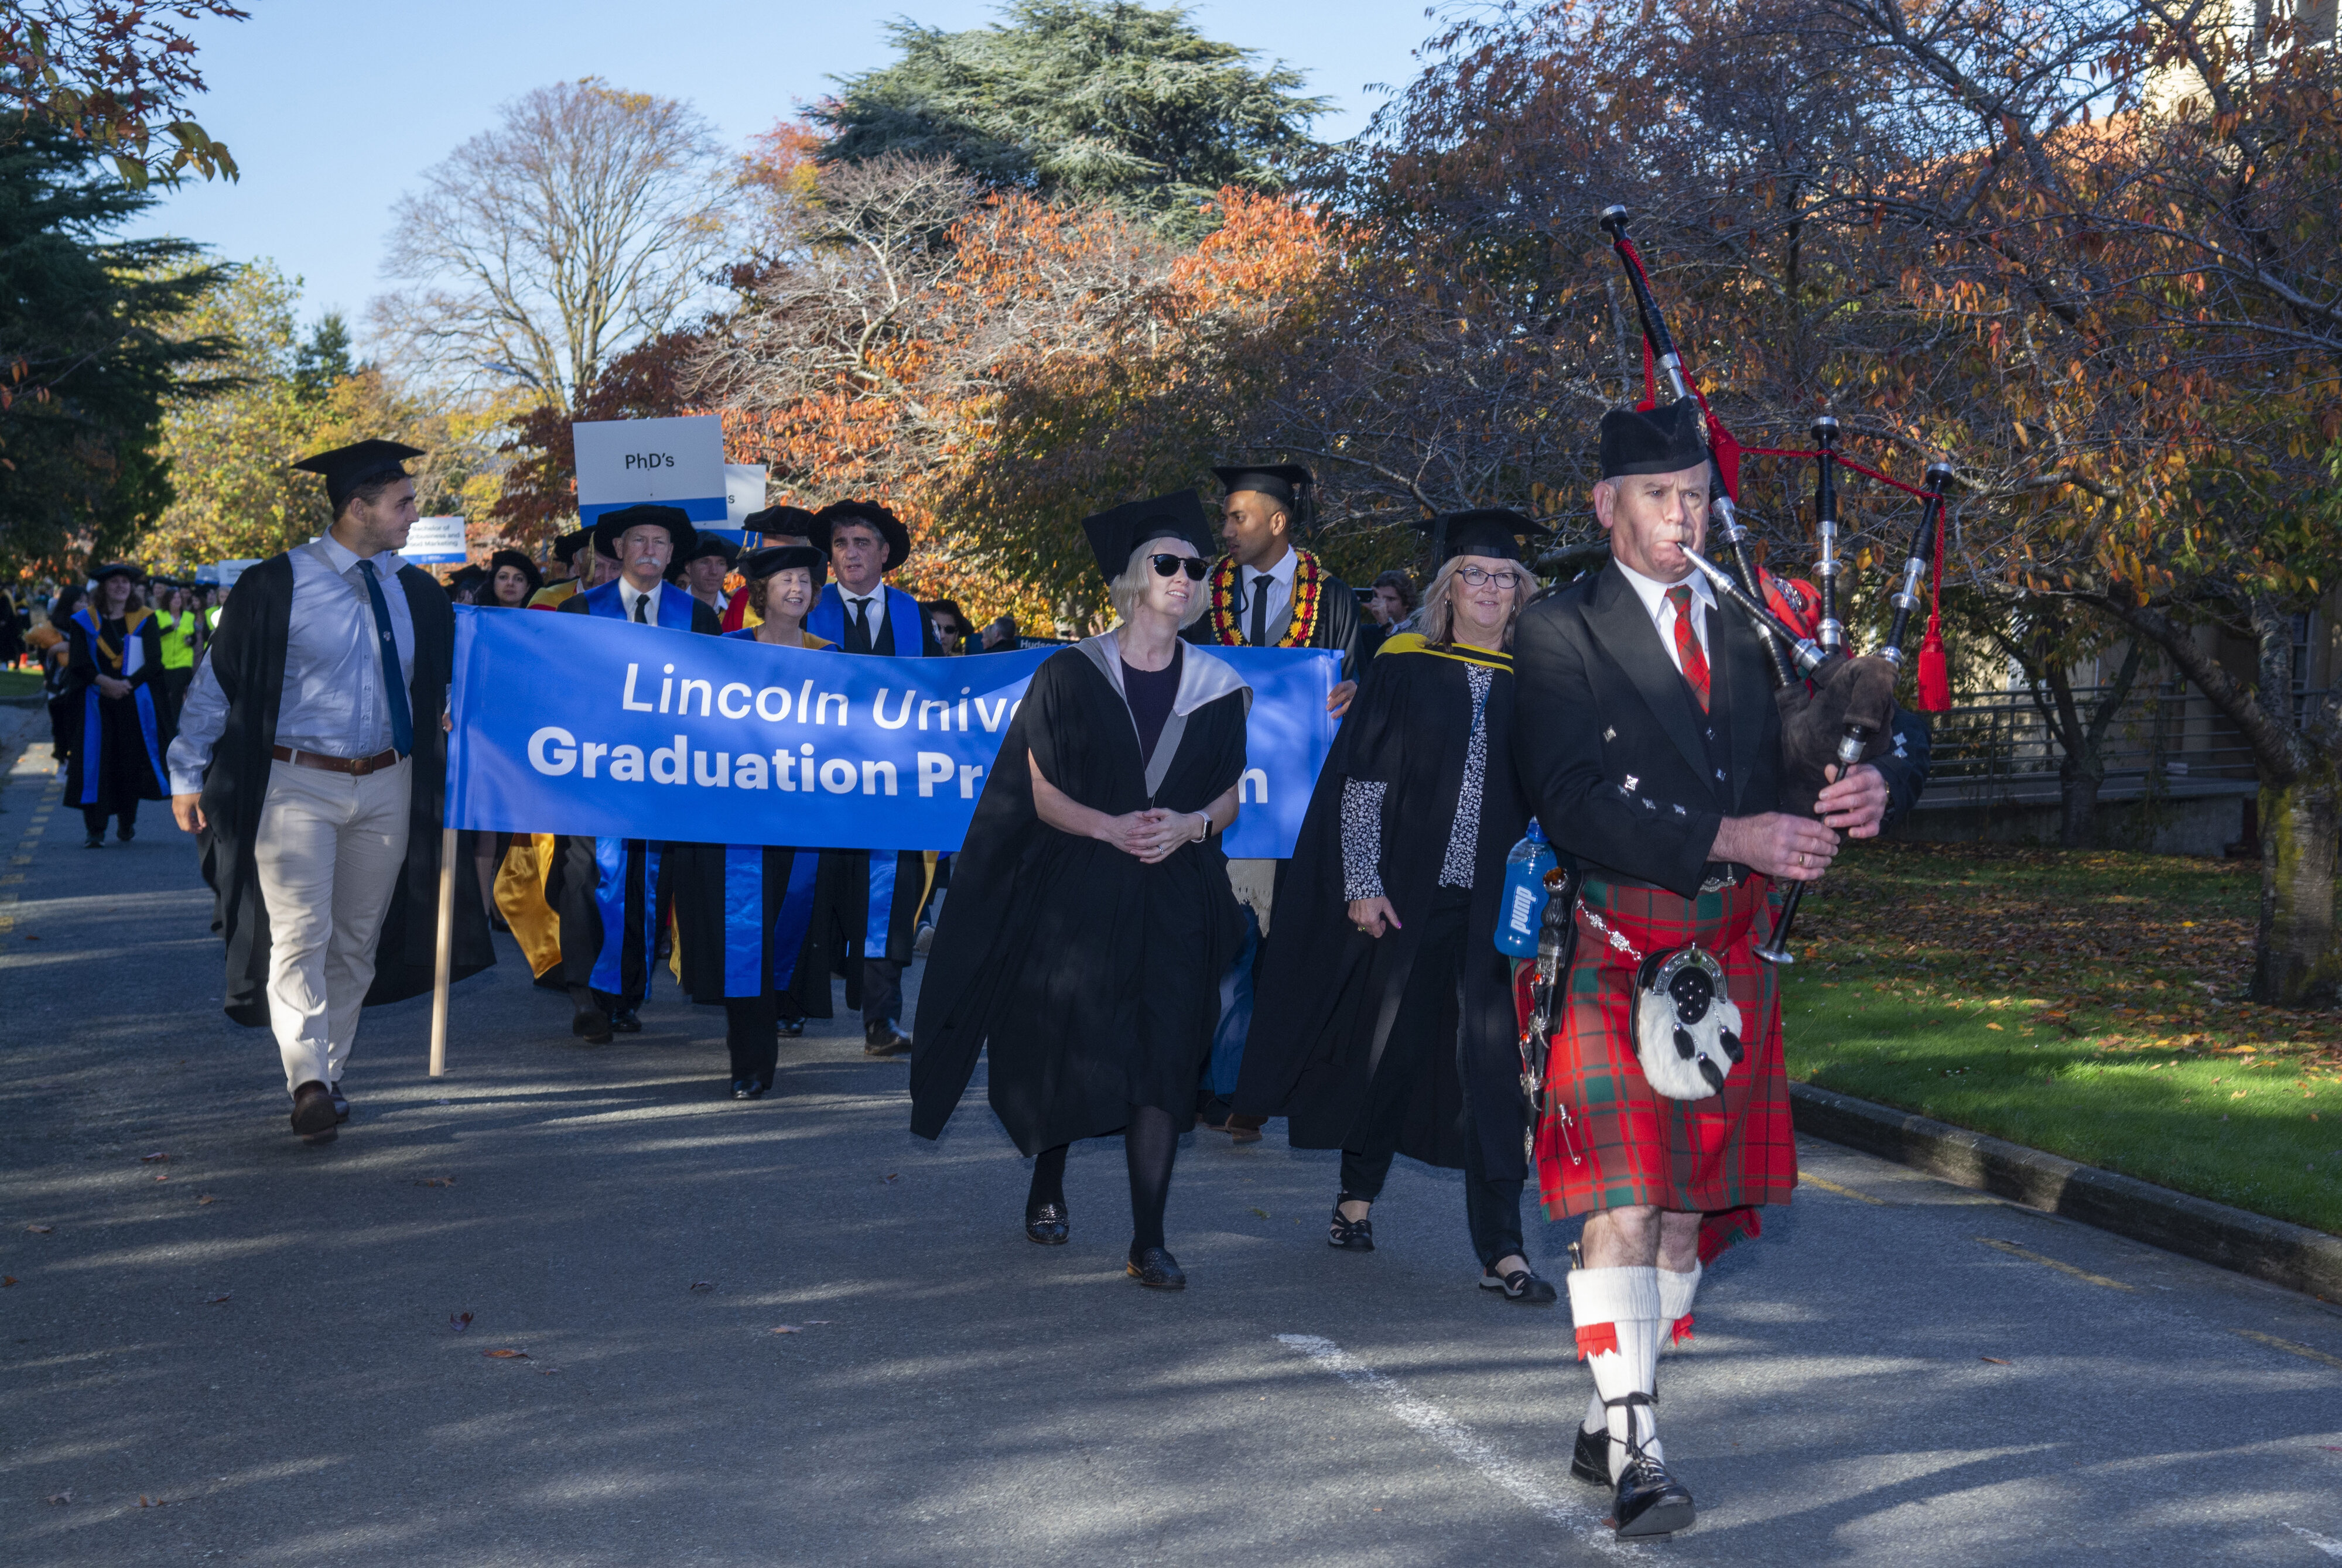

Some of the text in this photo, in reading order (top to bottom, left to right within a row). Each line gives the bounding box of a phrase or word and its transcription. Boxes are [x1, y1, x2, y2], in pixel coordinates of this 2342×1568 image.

[625, 453, 675, 469] PhD's
[622, 663, 849, 726] Lincoln
[528, 726, 983, 799] Graduation Pr
